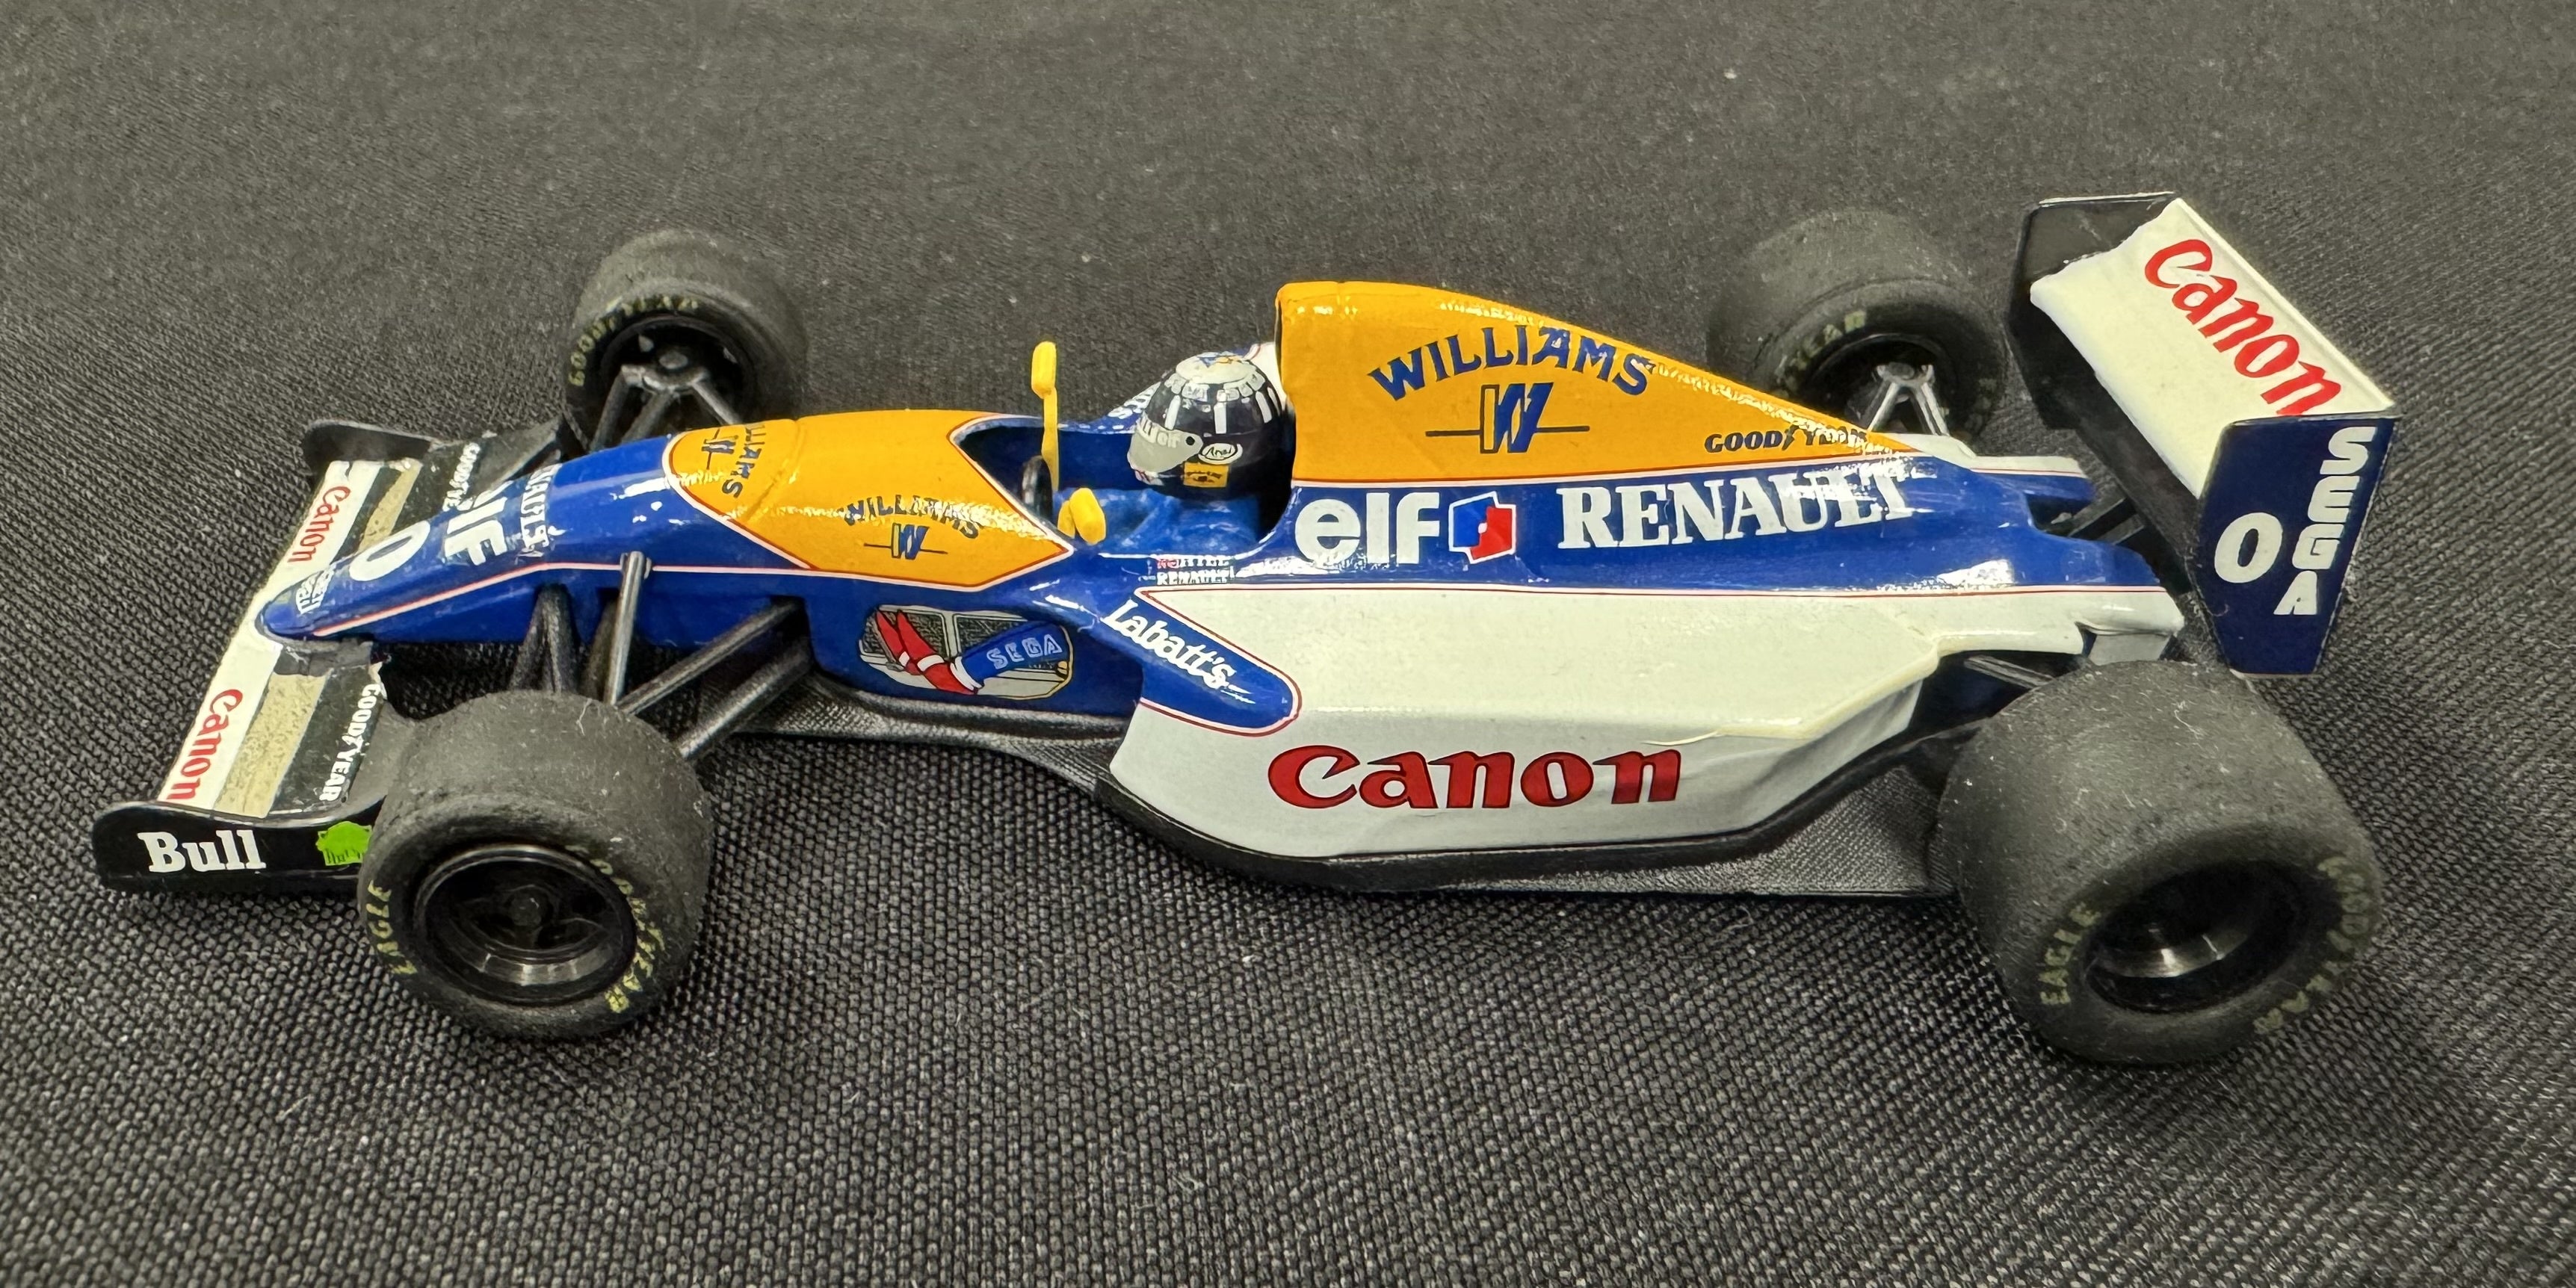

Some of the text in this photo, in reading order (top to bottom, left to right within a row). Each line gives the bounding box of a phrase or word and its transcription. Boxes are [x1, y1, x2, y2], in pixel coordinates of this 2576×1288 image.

[1368, 326, 1654, 401] WILLIAMS
[2144, 239, 2342, 416] Canon
[288, 486, 351, 562] Canon
[1295, 492, 1439, 564] elf
[1557, 466, 1912, 549] RENAULT
[2273, 427, 2376, 616] SEGA
[986, 634, 1063, 669] SEGA
[1100, 599, 1238, 692] Labatt's
[166, 689, 244, 801] Canon
[319, 683, 383, 802] GOODYEAR
[1268, 745, 1681, 808] Canon
[138, 829, 266, 873] Bull
